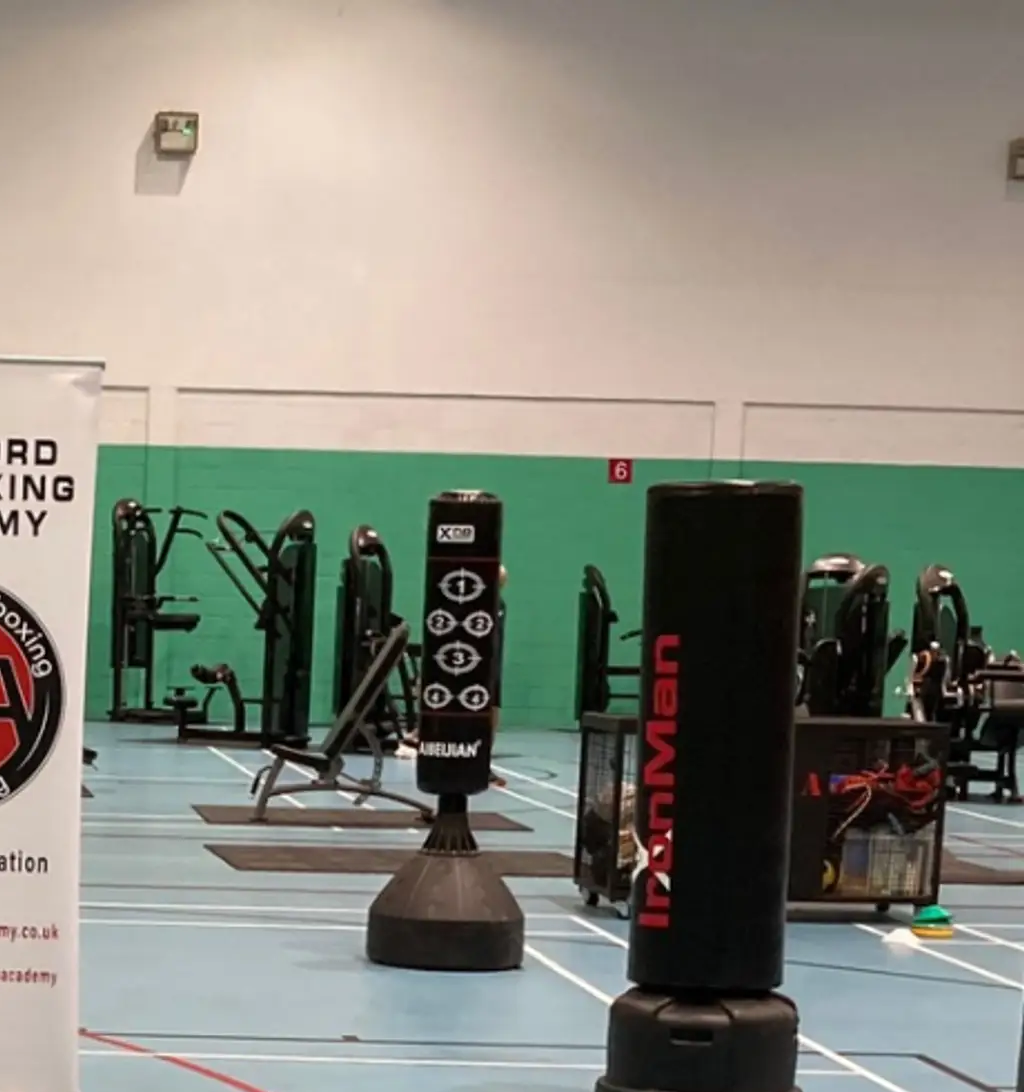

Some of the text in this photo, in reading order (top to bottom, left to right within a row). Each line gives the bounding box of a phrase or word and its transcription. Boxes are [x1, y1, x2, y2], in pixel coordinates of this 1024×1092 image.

[615, 461, 628, 480] 6
[435, 616, 485, 630] 2 2
[452, 652, 465, 665] 3
[638, 634, 681, 928] IronMan
